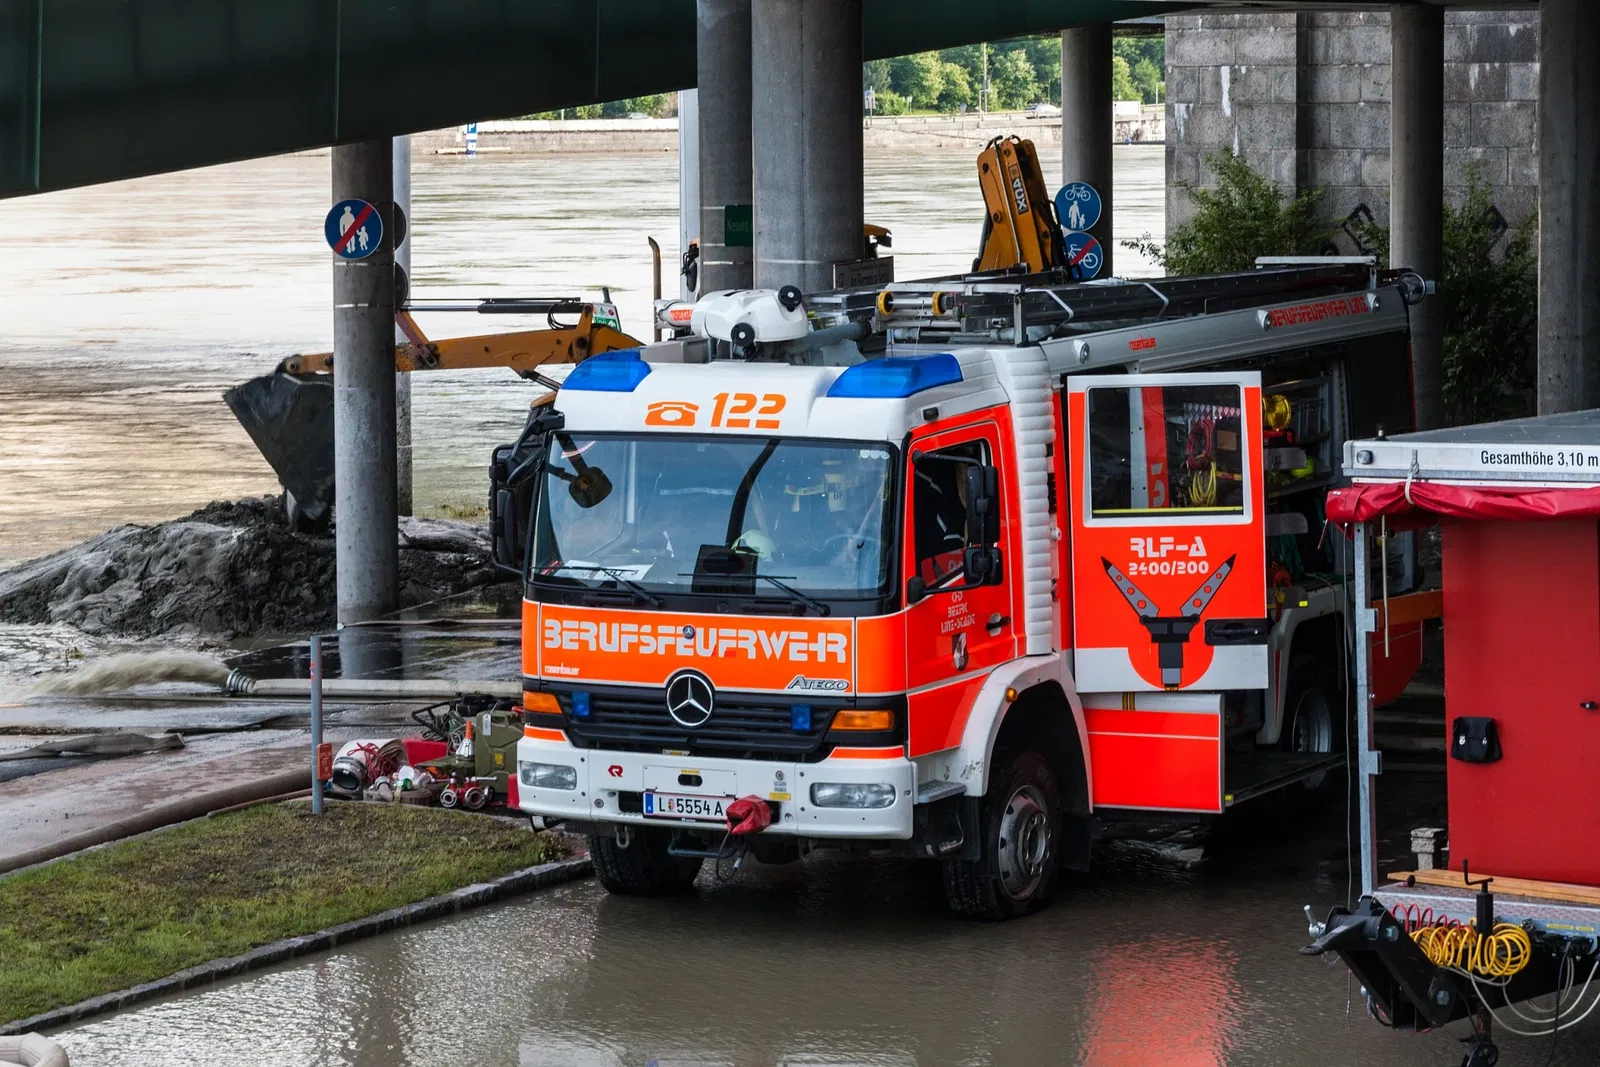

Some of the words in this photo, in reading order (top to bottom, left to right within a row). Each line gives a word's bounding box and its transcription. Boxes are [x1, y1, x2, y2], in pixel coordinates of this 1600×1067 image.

[1013, 178, 1027, 211] 4CX
[710, 392, 787, 429] 122
[1480, 450, 1554, 466] Gesamthöhe
[1557, 451, 1584, 468] 3,10
[1588, 455, 1599, 467] m
[1130, 536, 1208, 558] RLF-A
[1128, 560, 1209, 576] 2400/200
[544, 618, 847, 663] BERUFSFEUERWEHR
[658, 796, 666, 812] L
[676, 798, 711, 816] 5554
[714, 800, 724, 816] A
